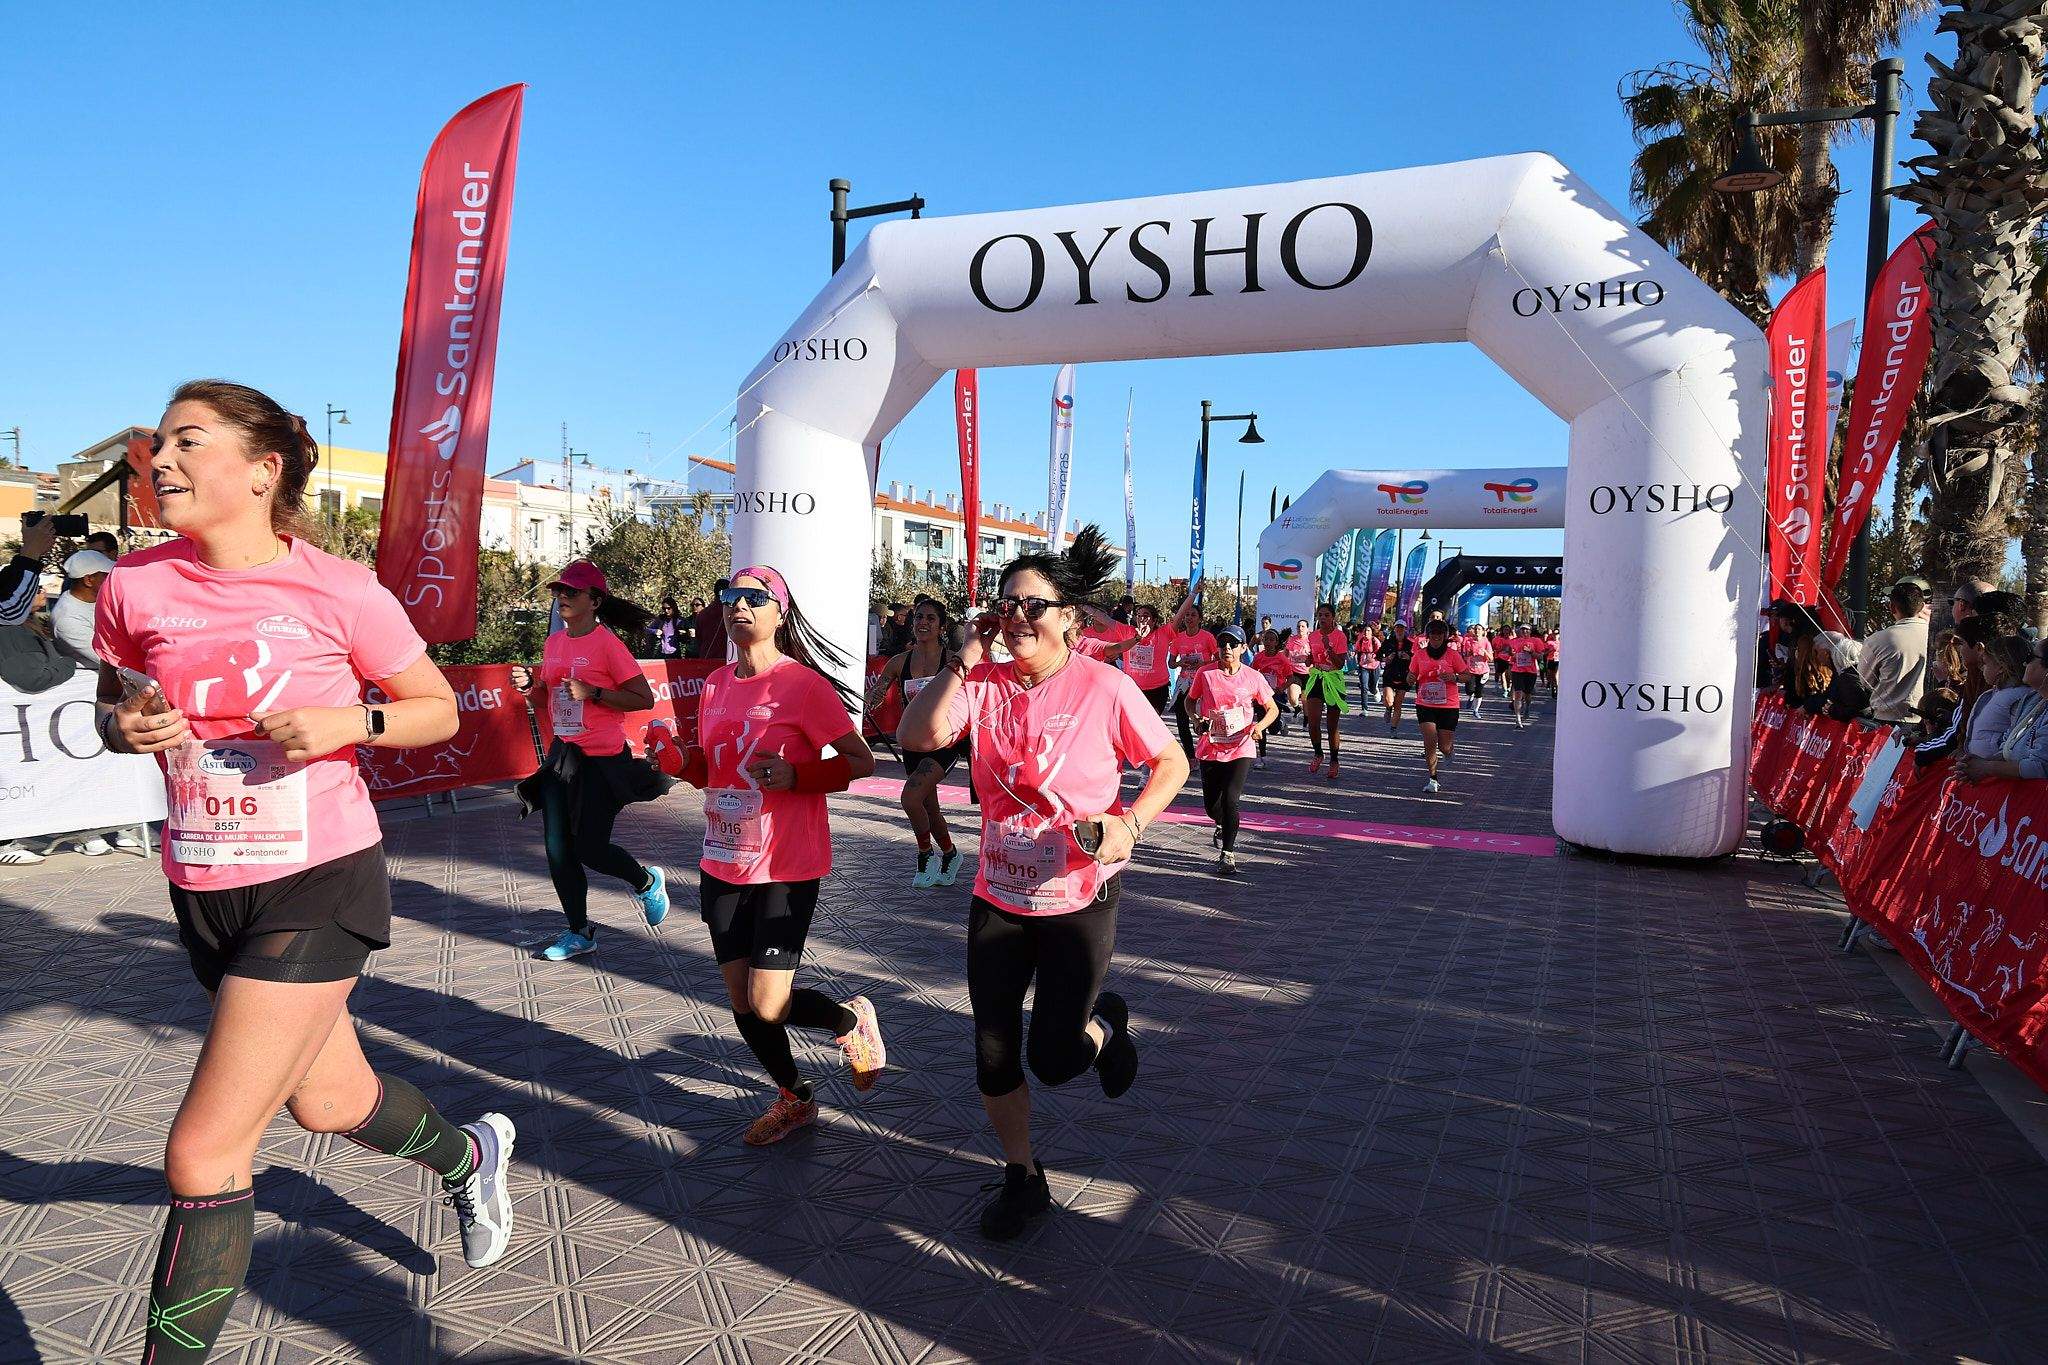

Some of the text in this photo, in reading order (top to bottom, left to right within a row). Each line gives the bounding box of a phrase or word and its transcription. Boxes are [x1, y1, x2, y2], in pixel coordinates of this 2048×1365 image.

[969, 202, 1372, 313] OYSHO
[1512, 279, 1665, 317] OYSHO
[774, 337, 868, 363] OYSHO
[404, 162, 490, 608] Sports Santander
[1785, 334, 1808, 501] Santander
[733, 491, 816, 515] OYSHO
[1589, 483, 1734, 515] OYSHO
[1377, 508, 1429, 516] TotalEnergies
[1483, 507, 1538, 515] TotalEnergies
[1353, 537, 1373, 606] Batiste
[1475, 565, 1563, 576] VOLVO
[1262, 583, 1302, 592] TotalEnergies
[147, 615, 208, 629] OYSHO
[1581, 680, 1723, 714] OYSHO
[202, 759, 253, 769] ASTURIANA
[205, 796, 258, 816] 016
[214, 821, 241, 831] 8557
[720, 821, 742, 835] 016
[180, 832, 204, 840] CARRERA
[205, 833, 213, 841] DE
[214, 833, 223, 841] LA
[1005, 838, 1035, 848] ASTURIANA
[179, 845, 288, 857] OYSHO Santander
[1007, 862, 1038, 879] 016
